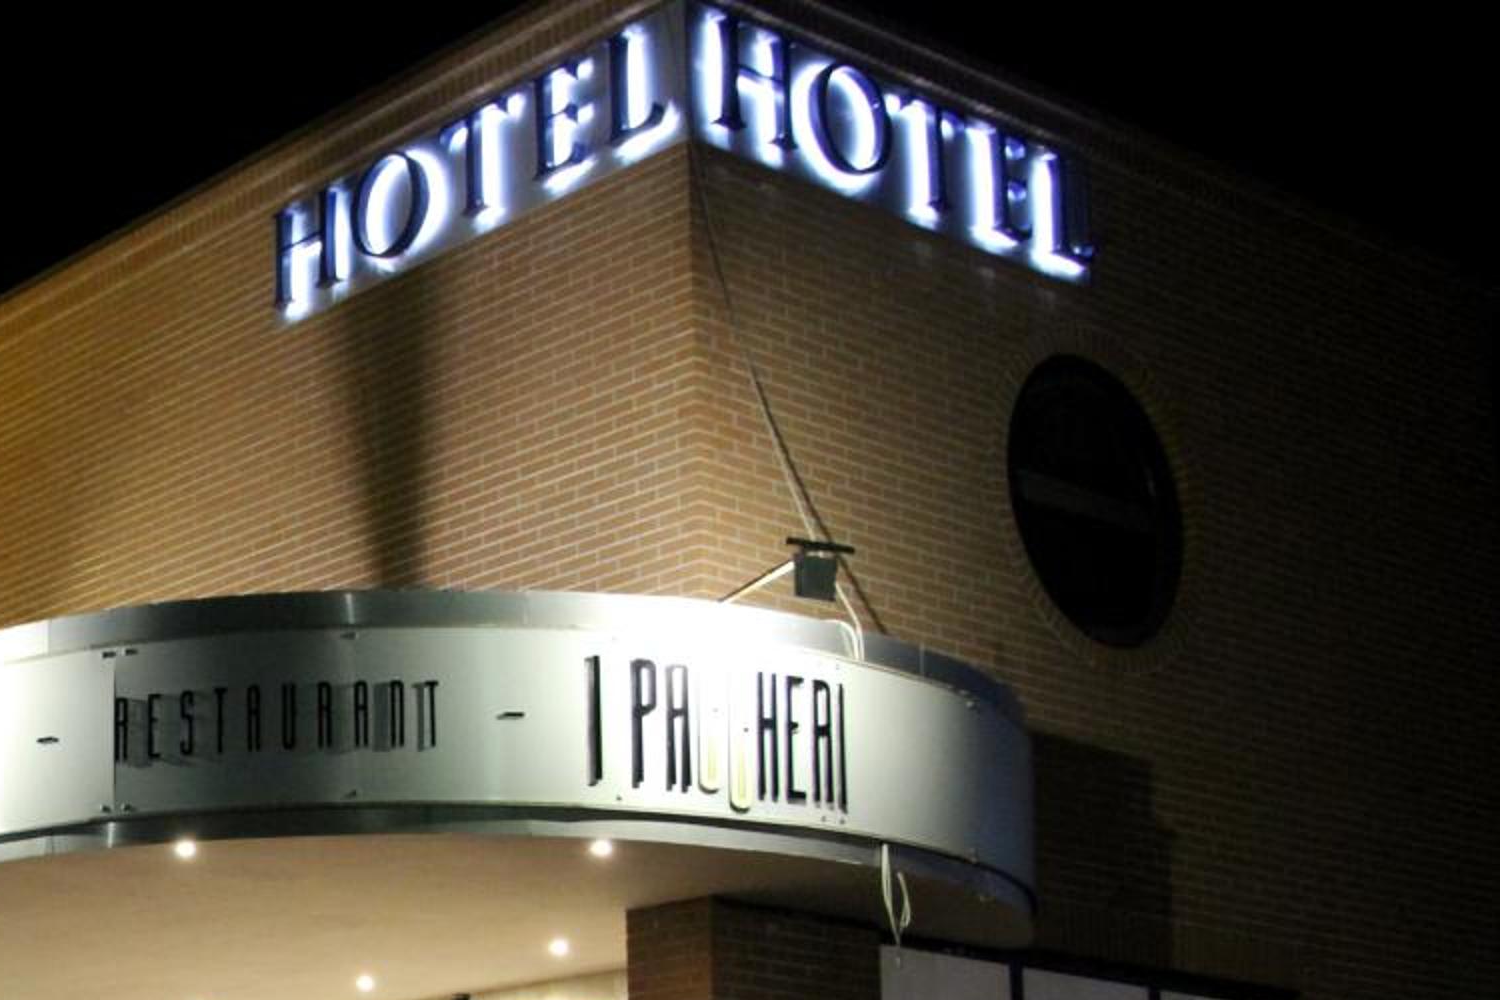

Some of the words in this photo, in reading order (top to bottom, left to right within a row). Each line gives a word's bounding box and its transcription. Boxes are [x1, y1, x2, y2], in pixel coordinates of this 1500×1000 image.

[275, 28, 680, 316] HOTEL
[700, 10, 1095, 278] HOTEL
[113, 680, 438, 763] RESTAURANT
